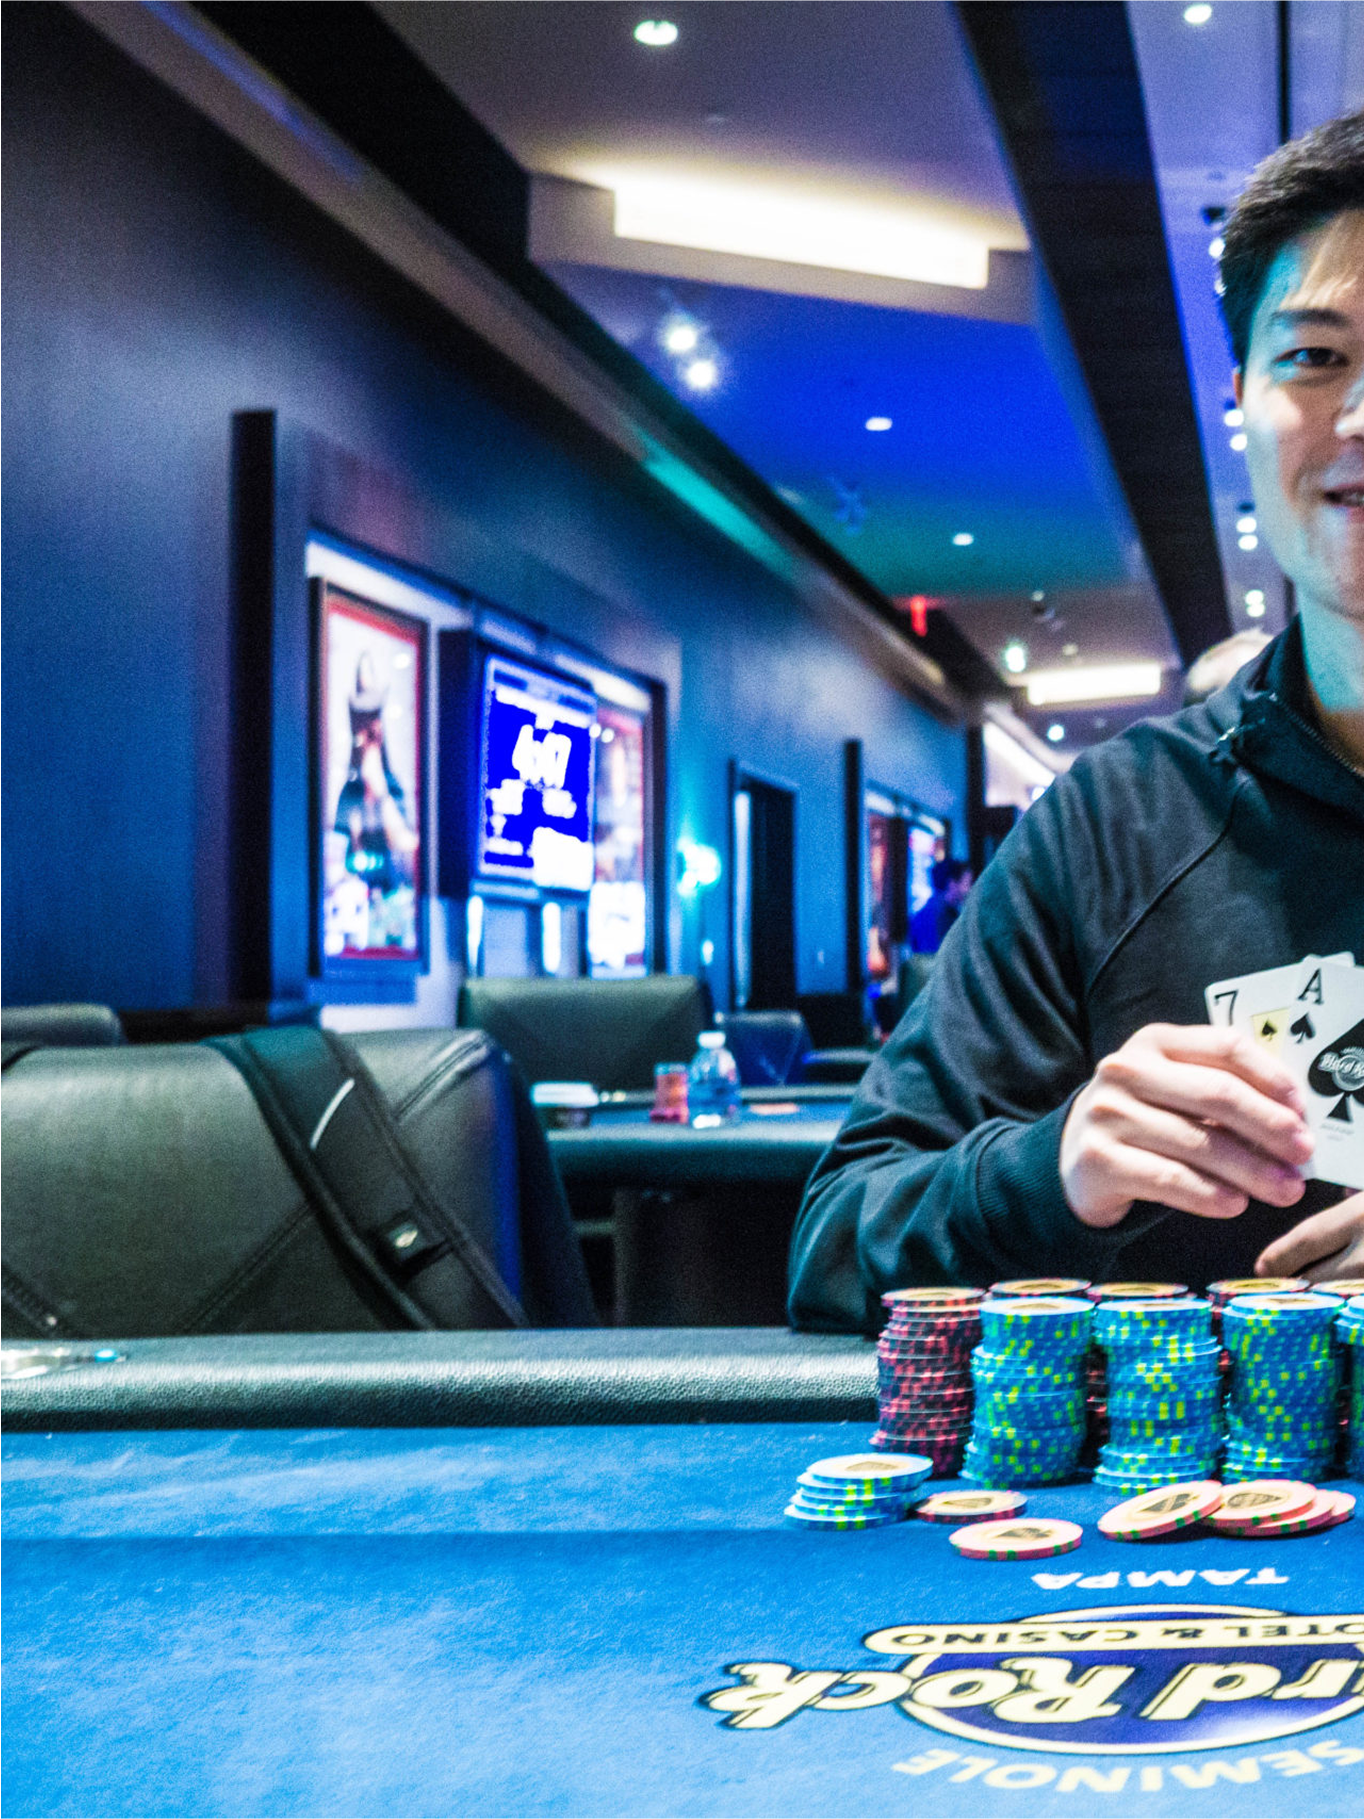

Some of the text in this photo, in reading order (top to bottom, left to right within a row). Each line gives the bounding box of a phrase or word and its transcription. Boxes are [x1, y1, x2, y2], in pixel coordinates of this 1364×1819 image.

[1297, 967, 1324, 1004] A
[1214, 989, 1239, 1026] 7
[1318, 1052, 1357, 1074] Hard
[1030, 1567, 1290, 1590] TAMPA
[890, 1628, 1141, 1646] CASINO
[1161, 1626, 1204, 1640] &
[702, 1655, 1137, 1730] Rock
